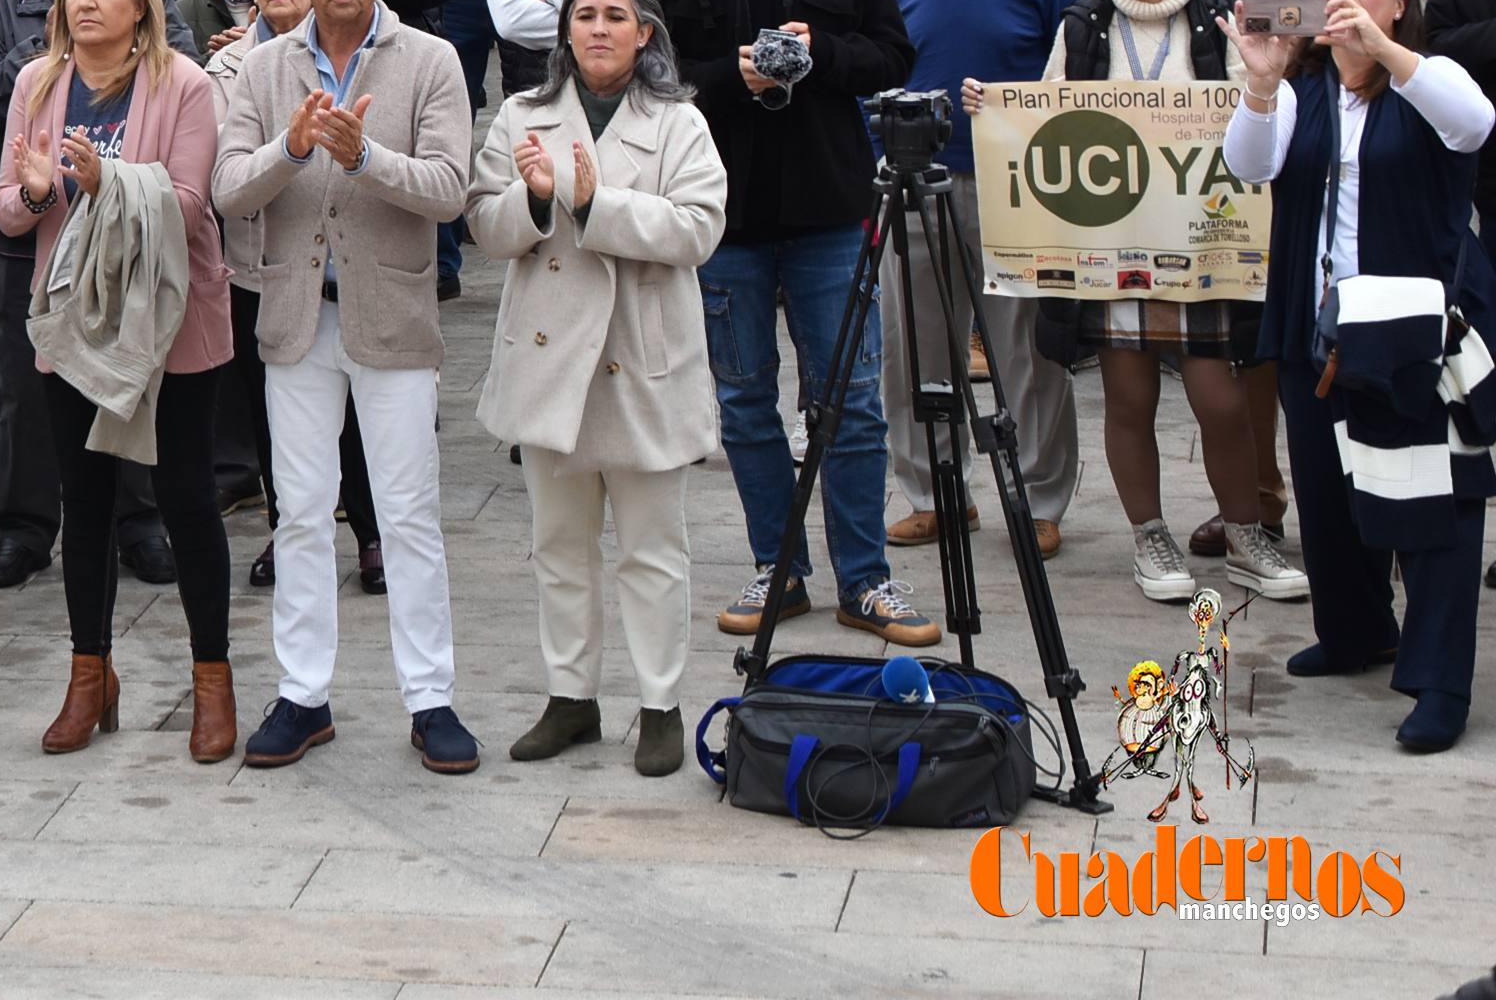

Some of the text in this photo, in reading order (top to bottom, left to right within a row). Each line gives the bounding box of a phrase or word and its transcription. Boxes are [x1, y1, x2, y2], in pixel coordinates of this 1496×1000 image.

[1002, 87, 1241, 109] Plan Funcional al 100
[1151, 112, 1232, 126] Hospital Ge
[1175, 129, 1225, 141] de Tom
[1008, 145, 1262, 208] ¡UCI YA
[1188, 219, 1249, 230] PLATAFORMA
